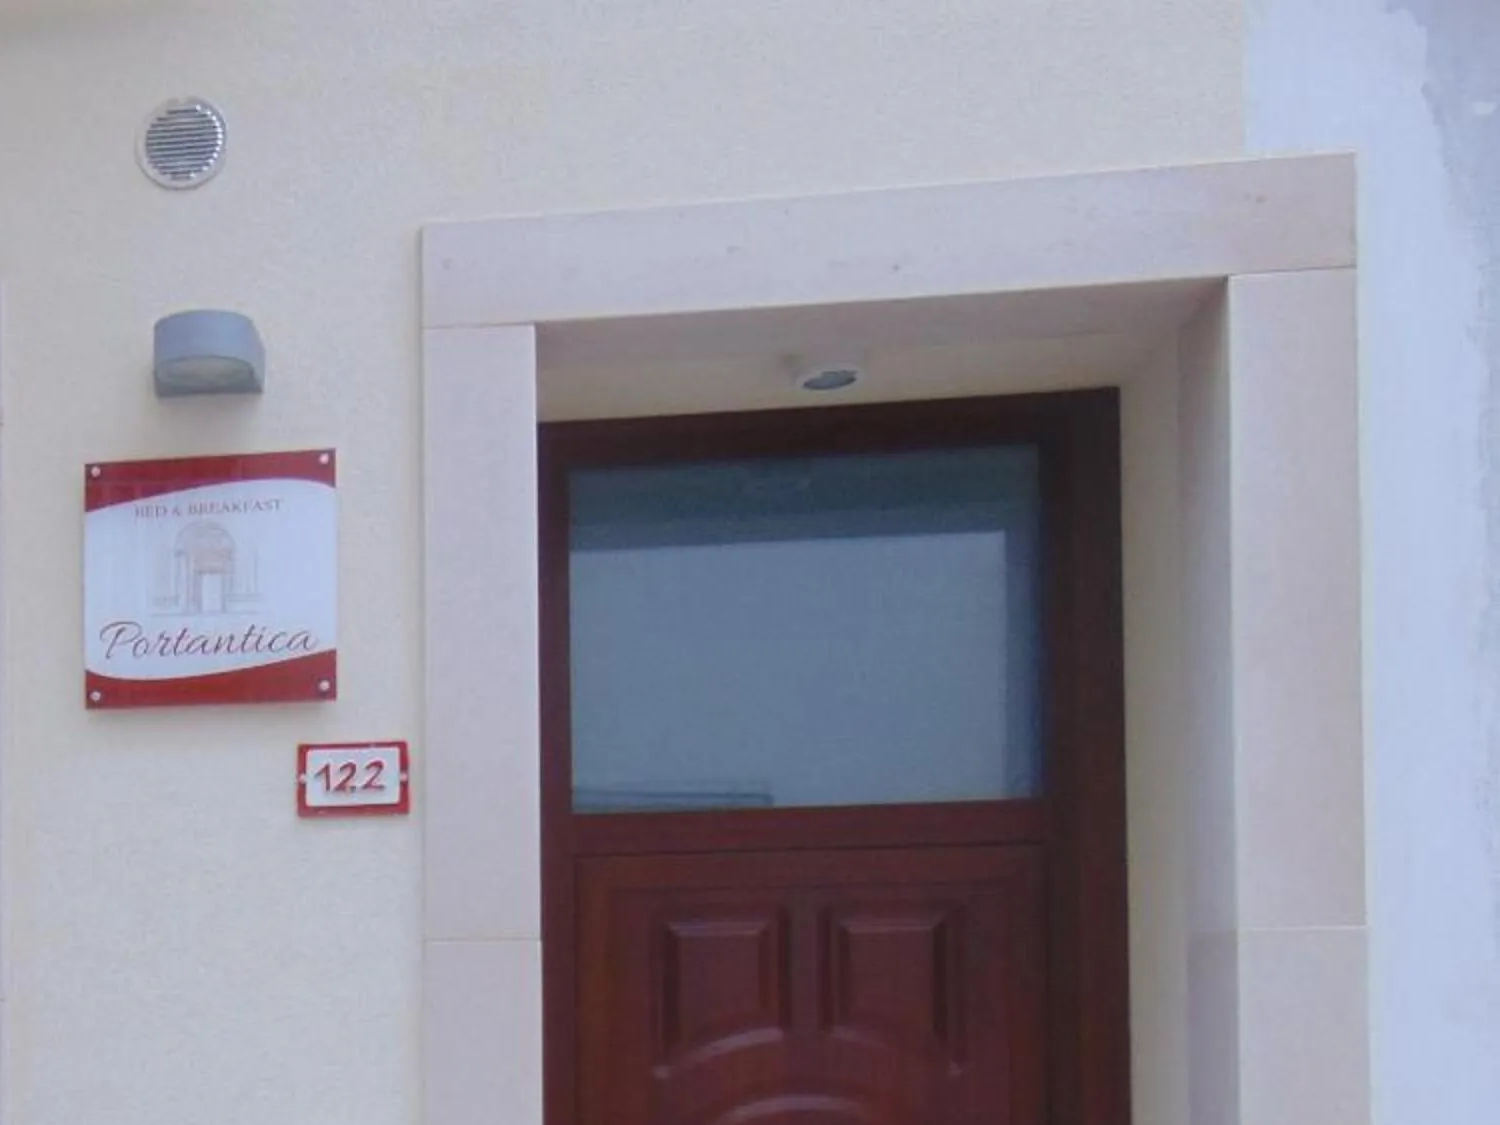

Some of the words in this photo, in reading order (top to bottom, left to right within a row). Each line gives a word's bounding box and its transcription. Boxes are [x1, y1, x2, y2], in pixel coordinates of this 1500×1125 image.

[134, 503, 167, 518] BED
[188, 498, 283, 515] BREAKFAST
[100, 621, 316, 660] Portantica
[314, 760, 386, 792] 122
